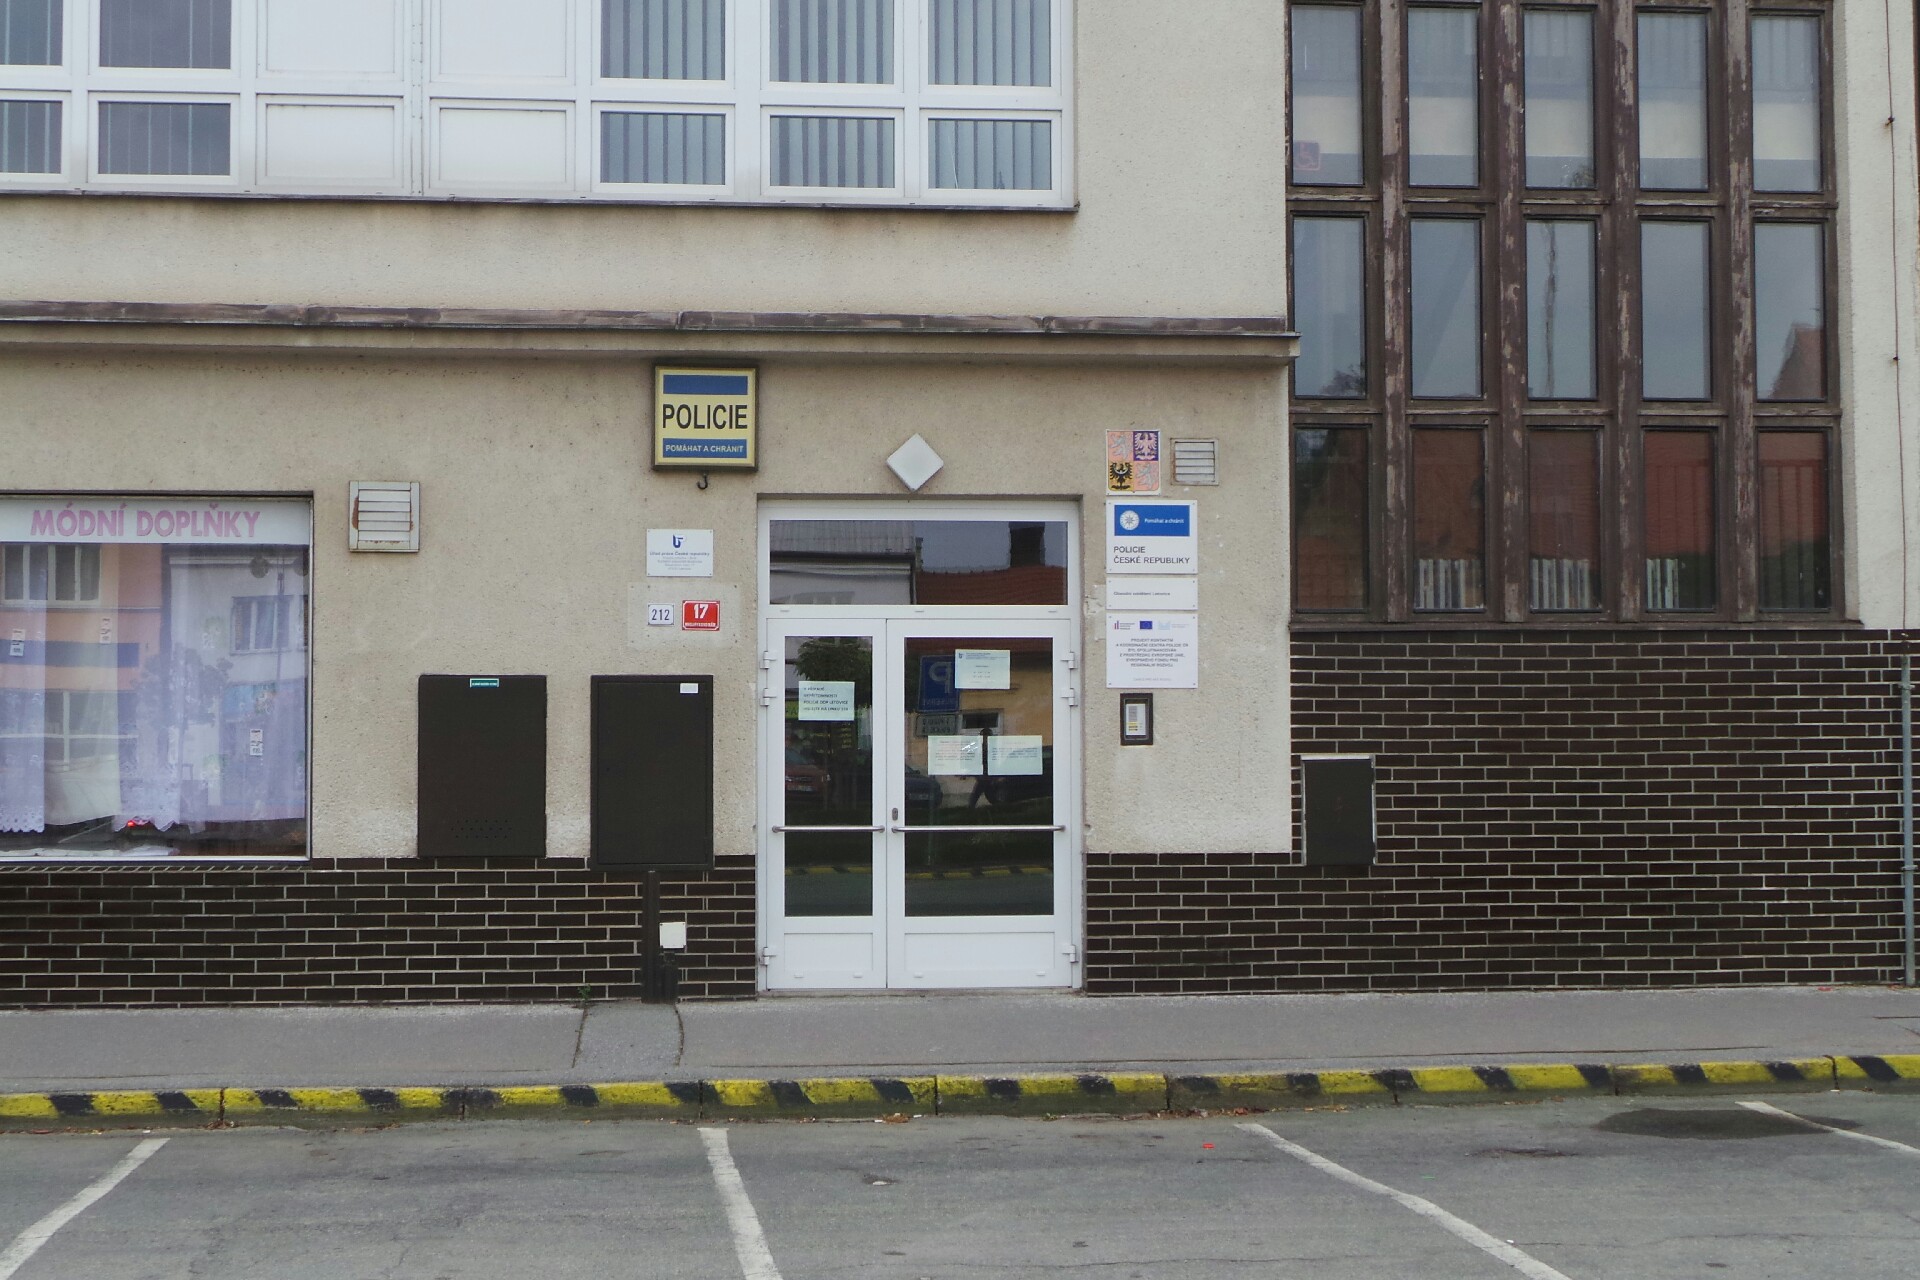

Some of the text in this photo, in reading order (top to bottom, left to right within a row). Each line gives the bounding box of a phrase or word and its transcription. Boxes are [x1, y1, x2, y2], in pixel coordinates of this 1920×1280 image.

[662, 403, 748, 430] POLICIE
[665, 443, 702, 452] POMÁHAT
[710, 443, 744, 453] CHRÁNIT
[30, 502, 260, 538] MÓDNÍ DOPLŇKY
[1113, 555, 1141, 564] ČESKÉ
[651, 608, 670, 621] 212
[693, 603, 709, 619] 17
